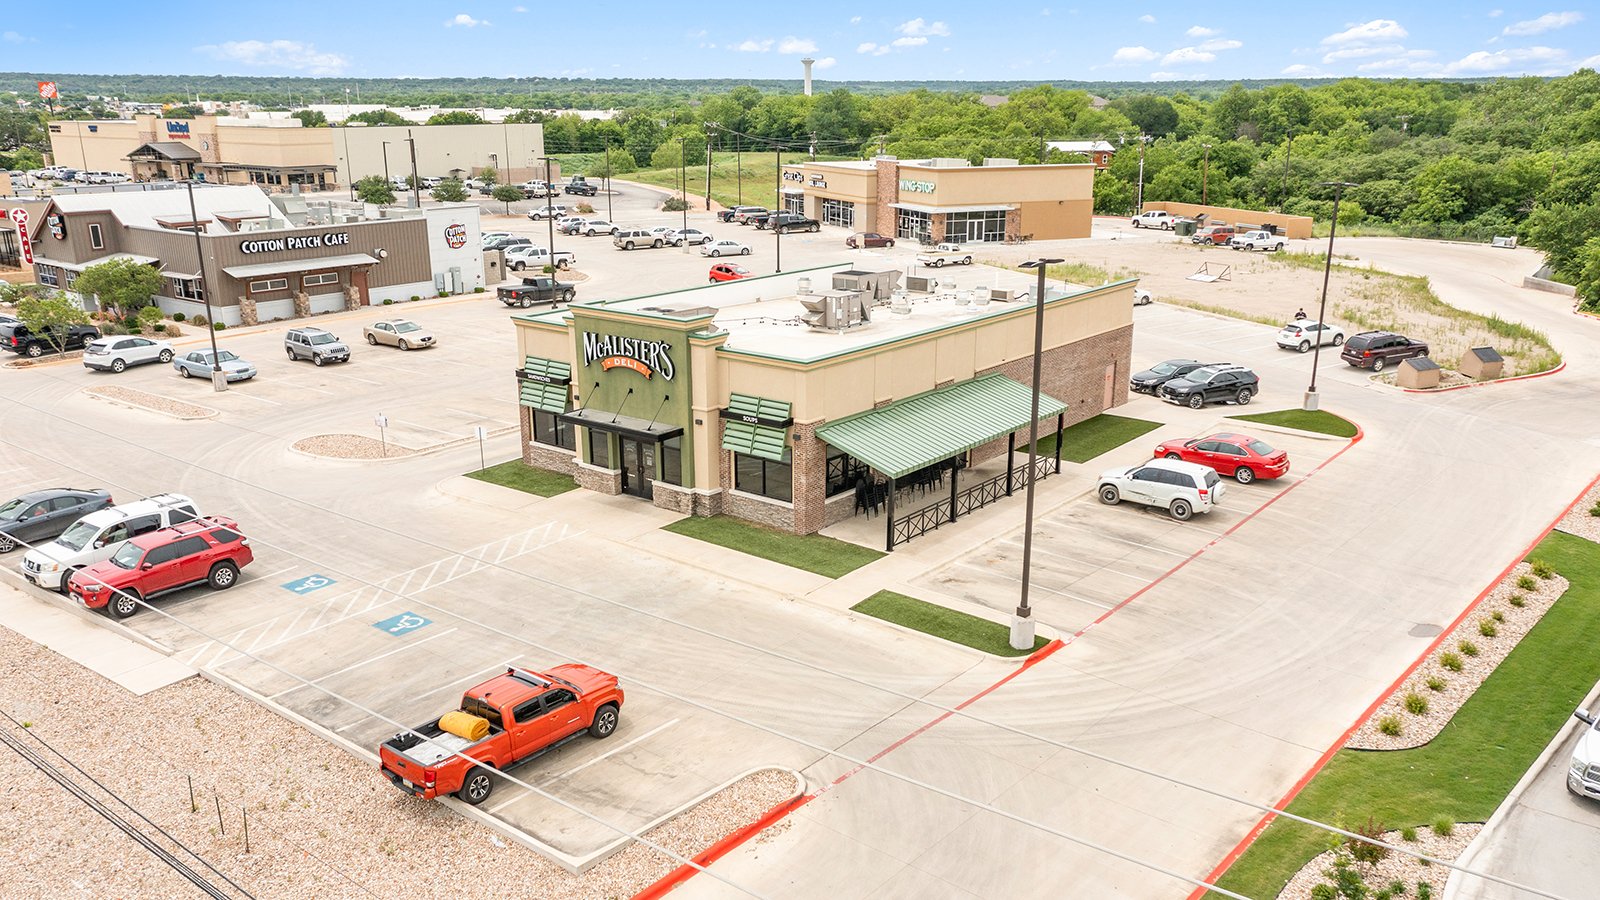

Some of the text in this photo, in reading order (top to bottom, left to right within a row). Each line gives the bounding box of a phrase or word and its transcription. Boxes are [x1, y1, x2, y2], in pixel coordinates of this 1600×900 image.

[20, 226, 32, 260] CAFE
[241, 233, 349, 254] COTTON PATCH CAFE
[613, 358, 637, 369] DELI
[742, 415, 758, 424] SOUPS
